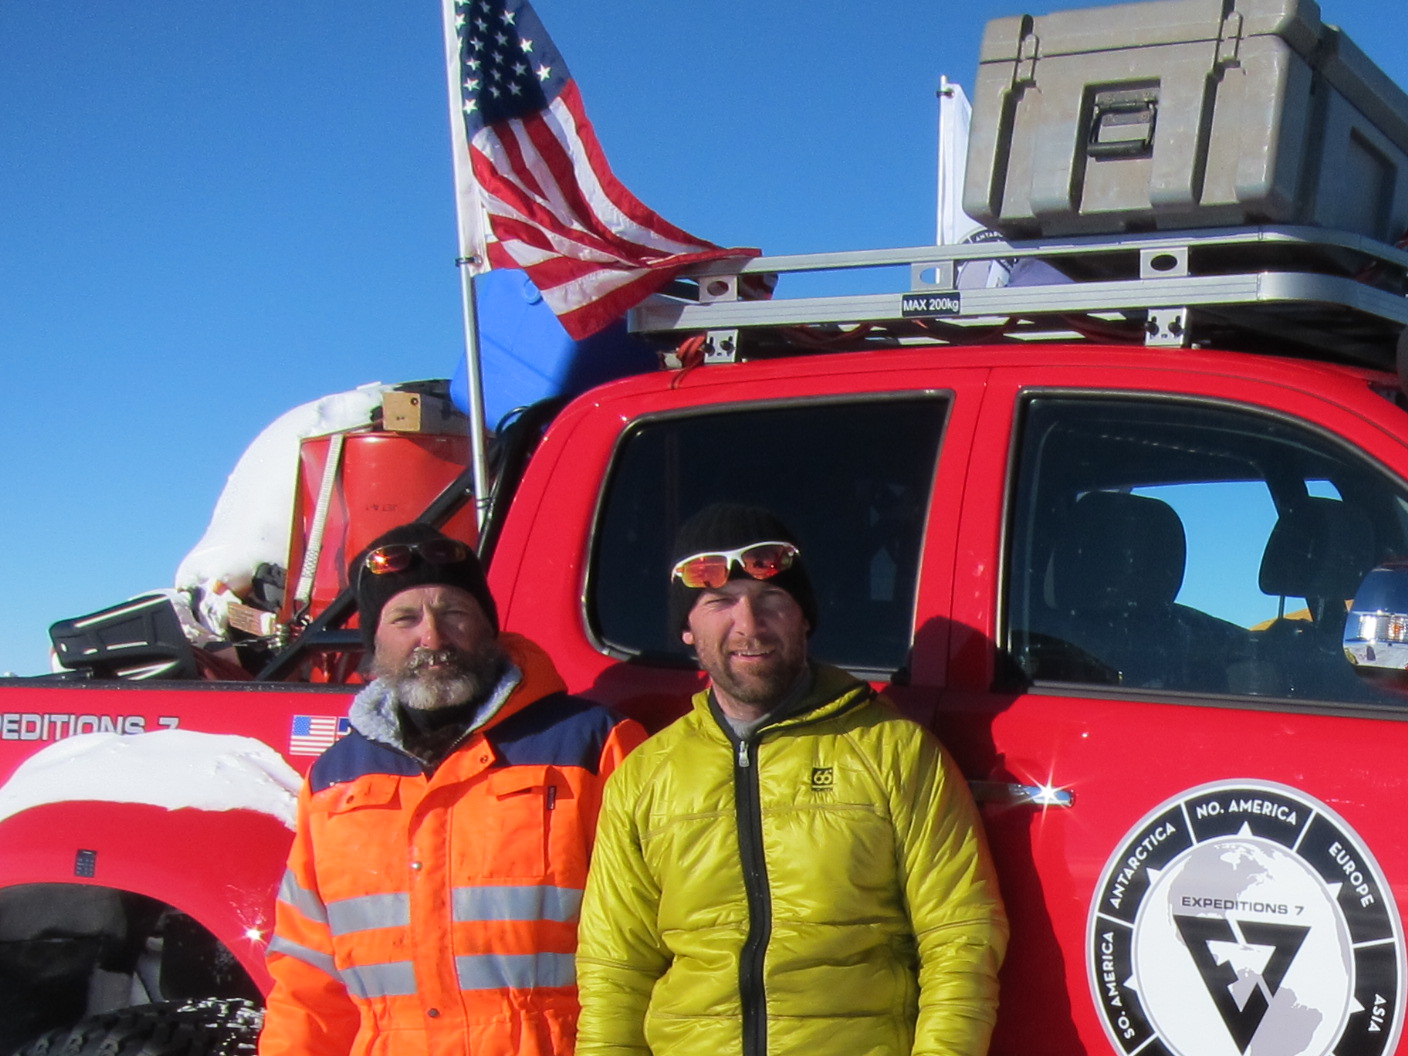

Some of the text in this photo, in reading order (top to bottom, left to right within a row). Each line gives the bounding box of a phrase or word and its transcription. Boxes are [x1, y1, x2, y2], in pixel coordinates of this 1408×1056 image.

[903, 297, 959, 312] MAX 200kg
[0, 713, 147, 741] EDITIONS
[1196, 799, 1297, 826] NO. AMERICA
[1110, 821, 1176, 909] ANTARCTICA
[1328, 841, 1375, 908] EUROPE
[1181, 895, 1304, 917] EXPEDITIONS 7
[1102, 931, 1136, 1039] SO. AMERICA
[1367, 993, 1388, 1033] ASIA
